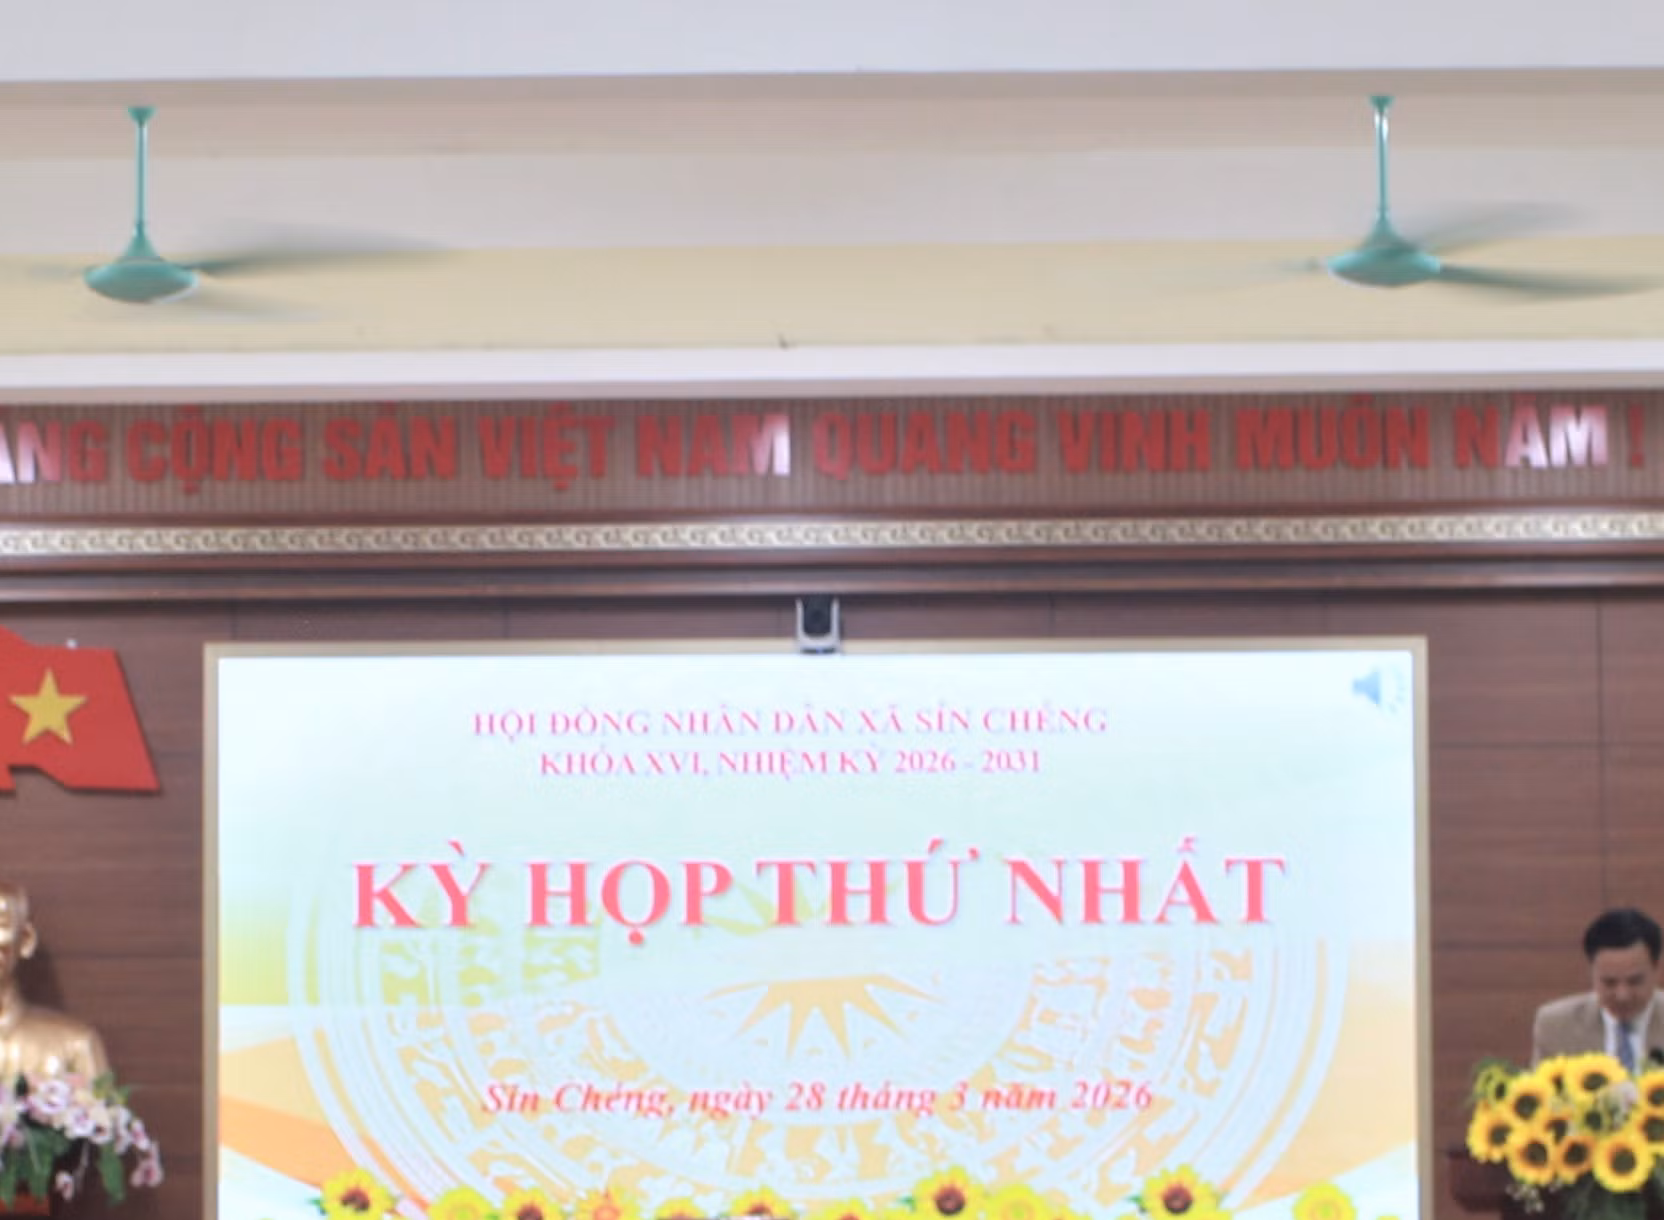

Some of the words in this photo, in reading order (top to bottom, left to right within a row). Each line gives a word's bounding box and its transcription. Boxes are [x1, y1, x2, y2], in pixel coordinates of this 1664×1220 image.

[125, 405, 305, 495] CỘNG
[322, 401, 455, 479] SẢN
[476, 402, 616, 490] VIỆT
[636, 413, 791, 478] NAM
[812, 410, 1038, 480] QUANG
[1058, 409, 1211, 473] VINH
[1236, 396, 1430, 469] MUÔN
[1453, 397, 1607, 468] NĂM
[1627, 405, 1644, 468] !
[473, 706, 536, 743] HỘI
[663, 703, 761, 735] NHÂN
[773, 703, 844, 734] DÂN
[858, 703, 904, 734] XÃ
[915, 700, 971, 734] SÍN
[646, 751, 709, 777] XVI,
[717, 744, 827, 781] NHIỆM
[839, 741, 885, 773] KỲ
[895, 750, 956, 774] 2026
[982, 749, 1040, 774] 2031
[352, 840, 493, 929] KỲ
[524, 859, 734, 947] HỌP
[755, 838, 981, 927] THỨ
[1002, 835, 1287, 926] NHẤT
[689, 1080, 772, 1120] ngày
[785, 1081, 828, 1112] 28
[836, 1080, 937, 1117] tháng
[948, 1080, 970, 1112] 3
[981, 1081, 1057, 1112] năm
[1071, 1079, 1154, 1111] 2026
